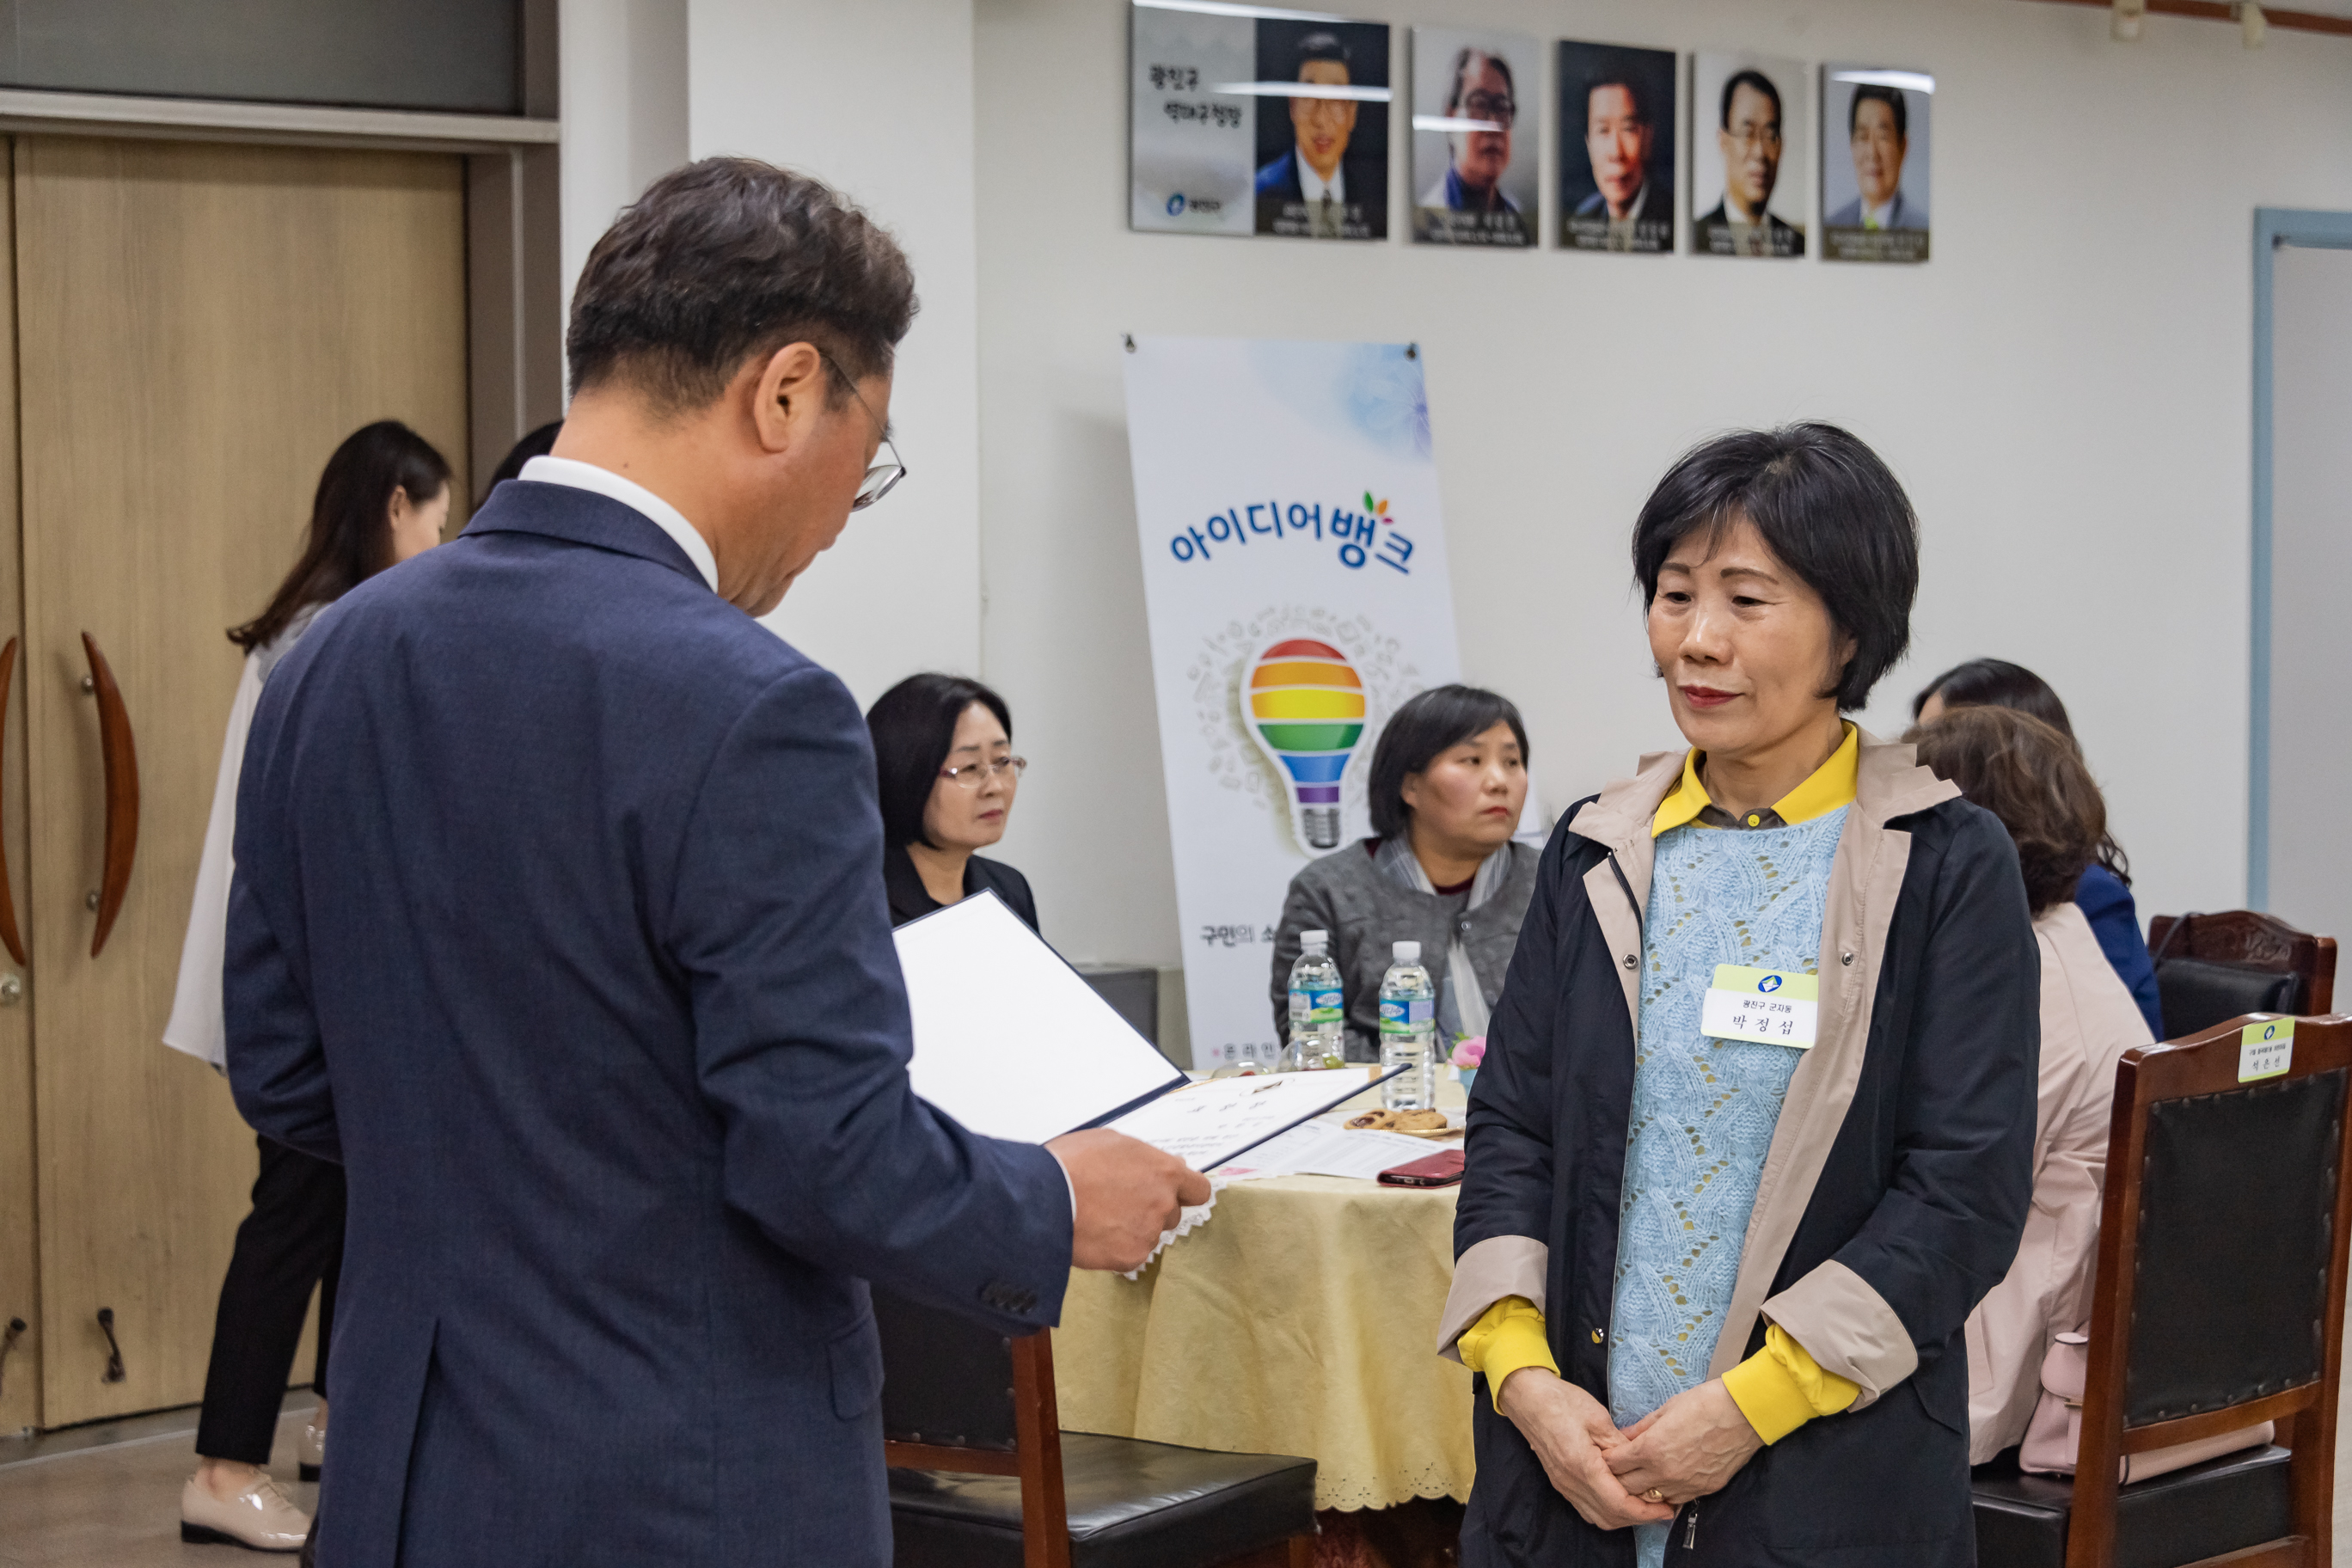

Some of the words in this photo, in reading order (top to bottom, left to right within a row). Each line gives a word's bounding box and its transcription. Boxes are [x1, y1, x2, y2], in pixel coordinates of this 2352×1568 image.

[1170, 501, 1414, 575] 아이디어뱅크
[1199, 925, 1254, 947] 구민의
[1743, 1000, 1766, 1010] 광진구
[1769, 1003, 1792, 1014] 군자동
